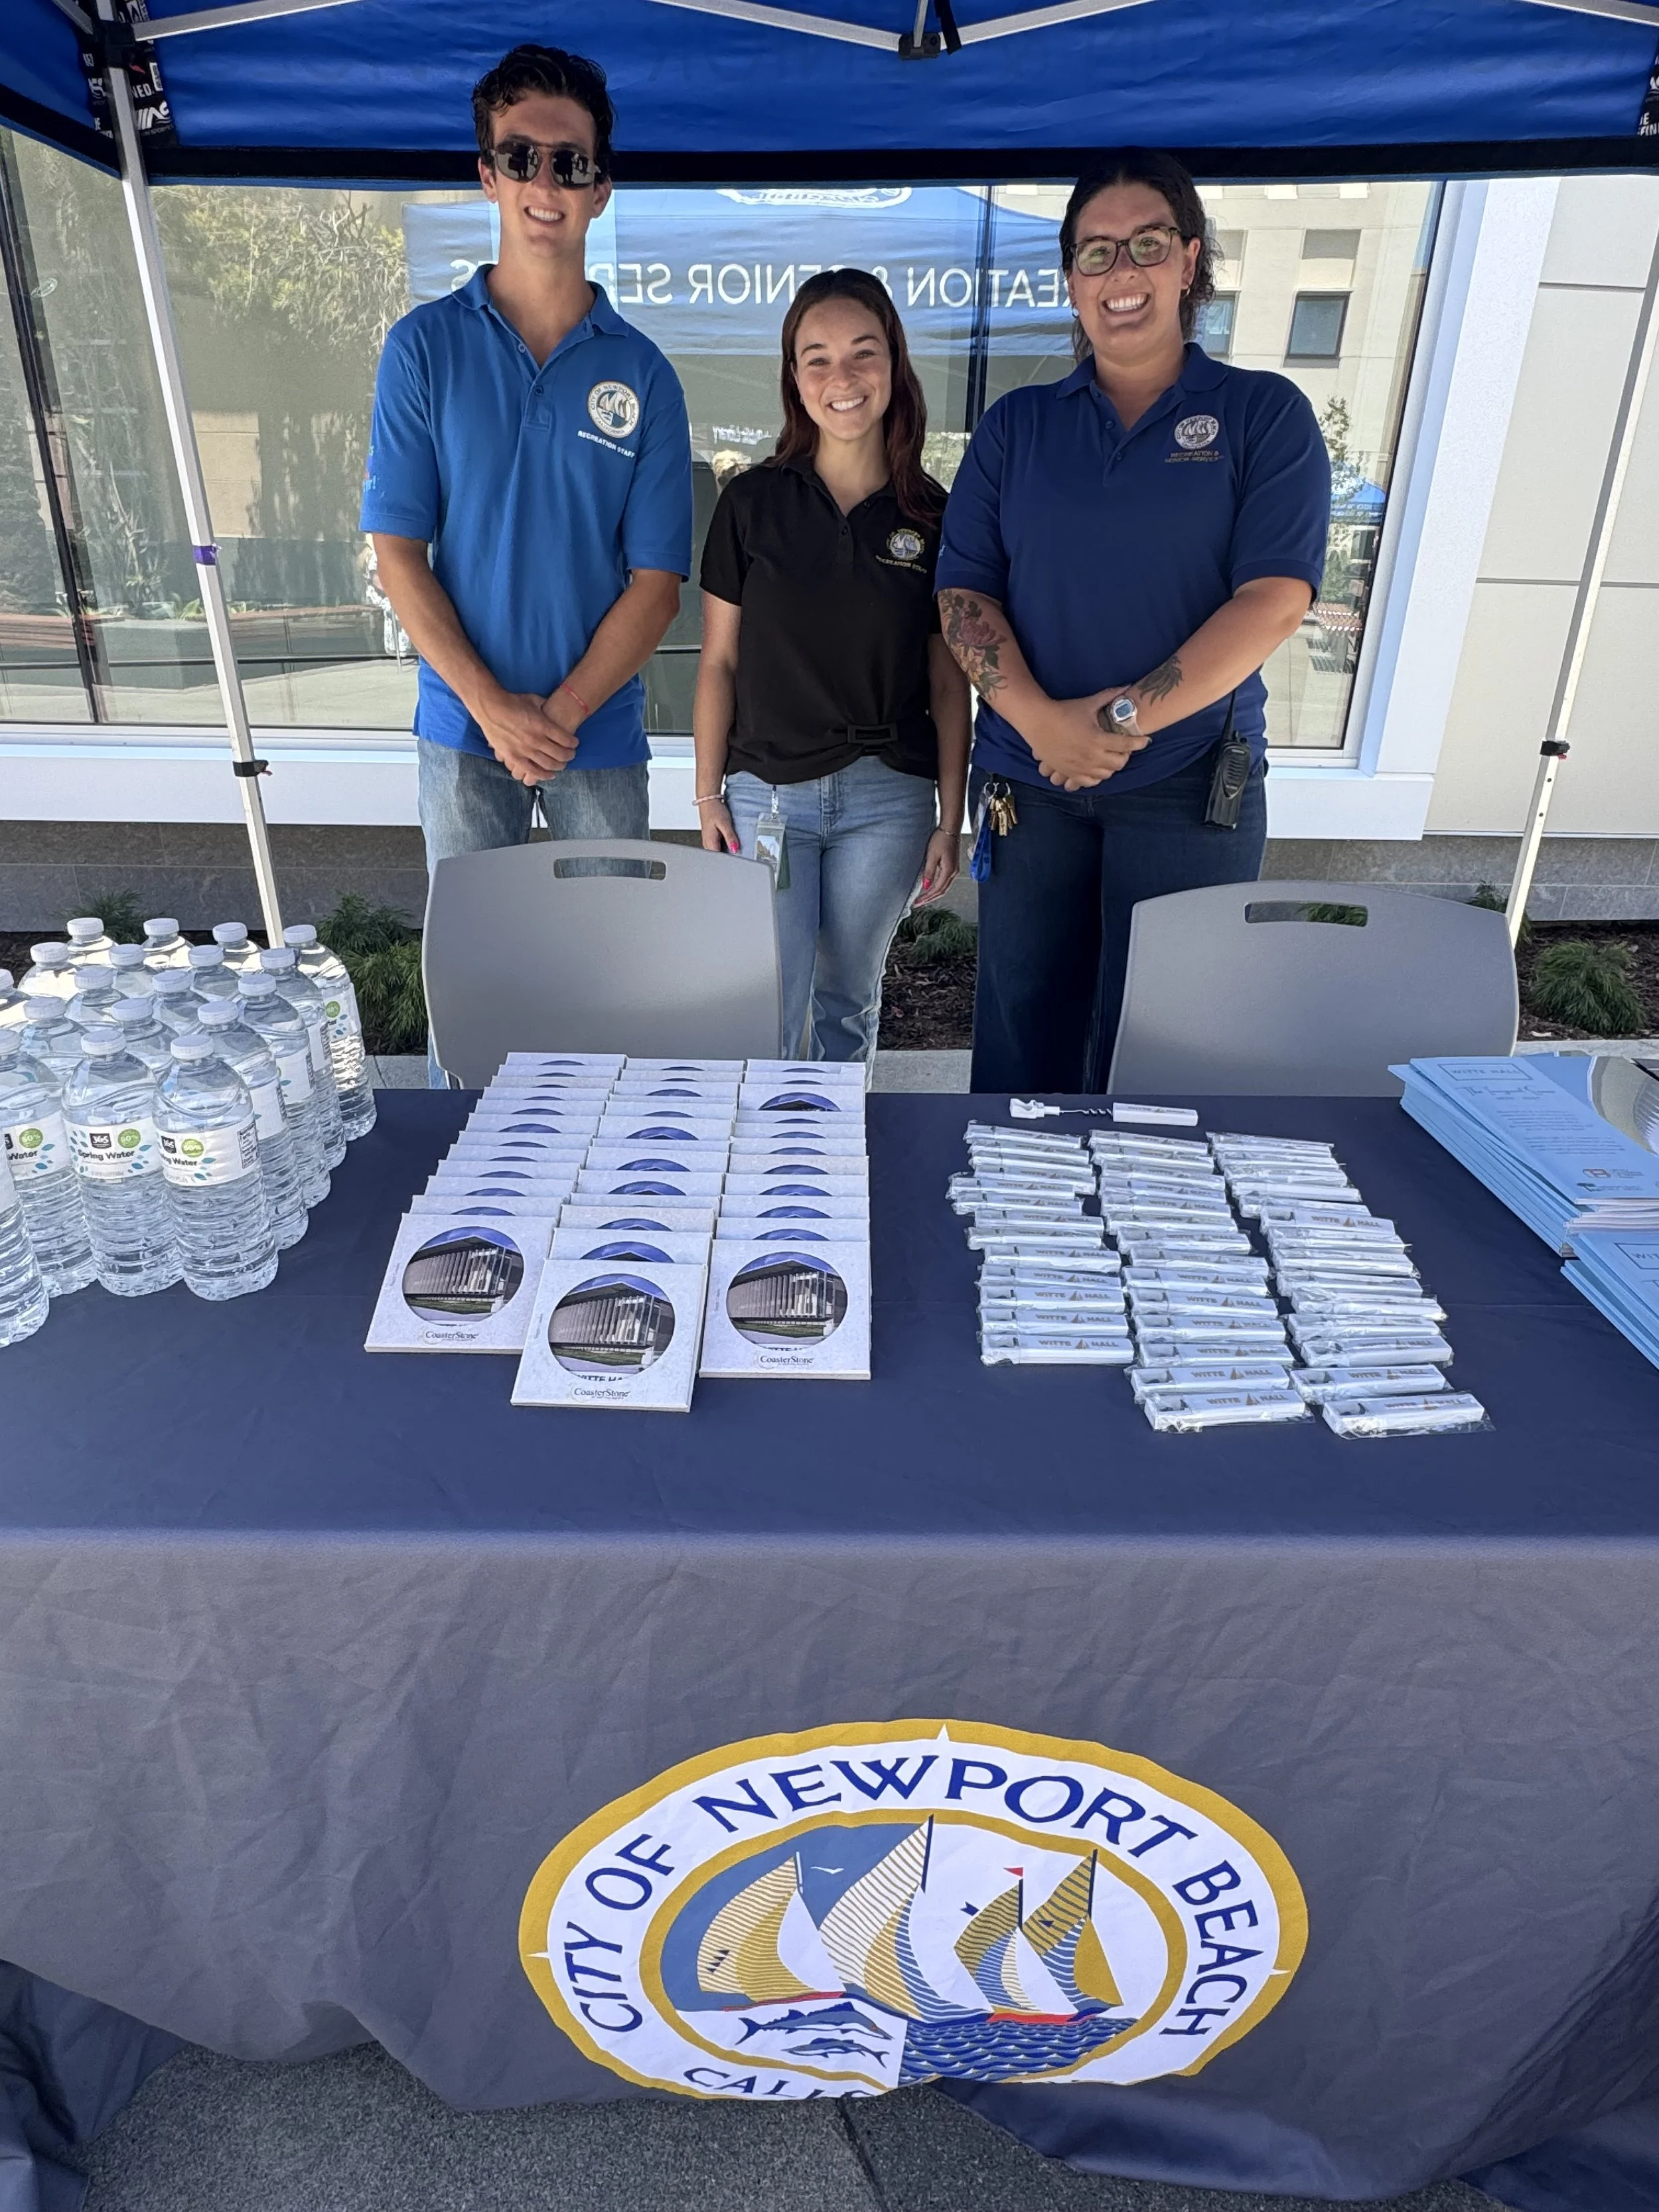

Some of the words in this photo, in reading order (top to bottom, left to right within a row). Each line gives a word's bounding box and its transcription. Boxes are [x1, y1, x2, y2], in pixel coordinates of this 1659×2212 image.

[105, 1151, 135, 1160] Water
[692, 1754, 1198, 1858] NEWPORT
[585, 1834, 675, 1911] OF
[564, 1921, 642, 2032] CITY
[1159, 1860, 1263, 2036] BEACH
